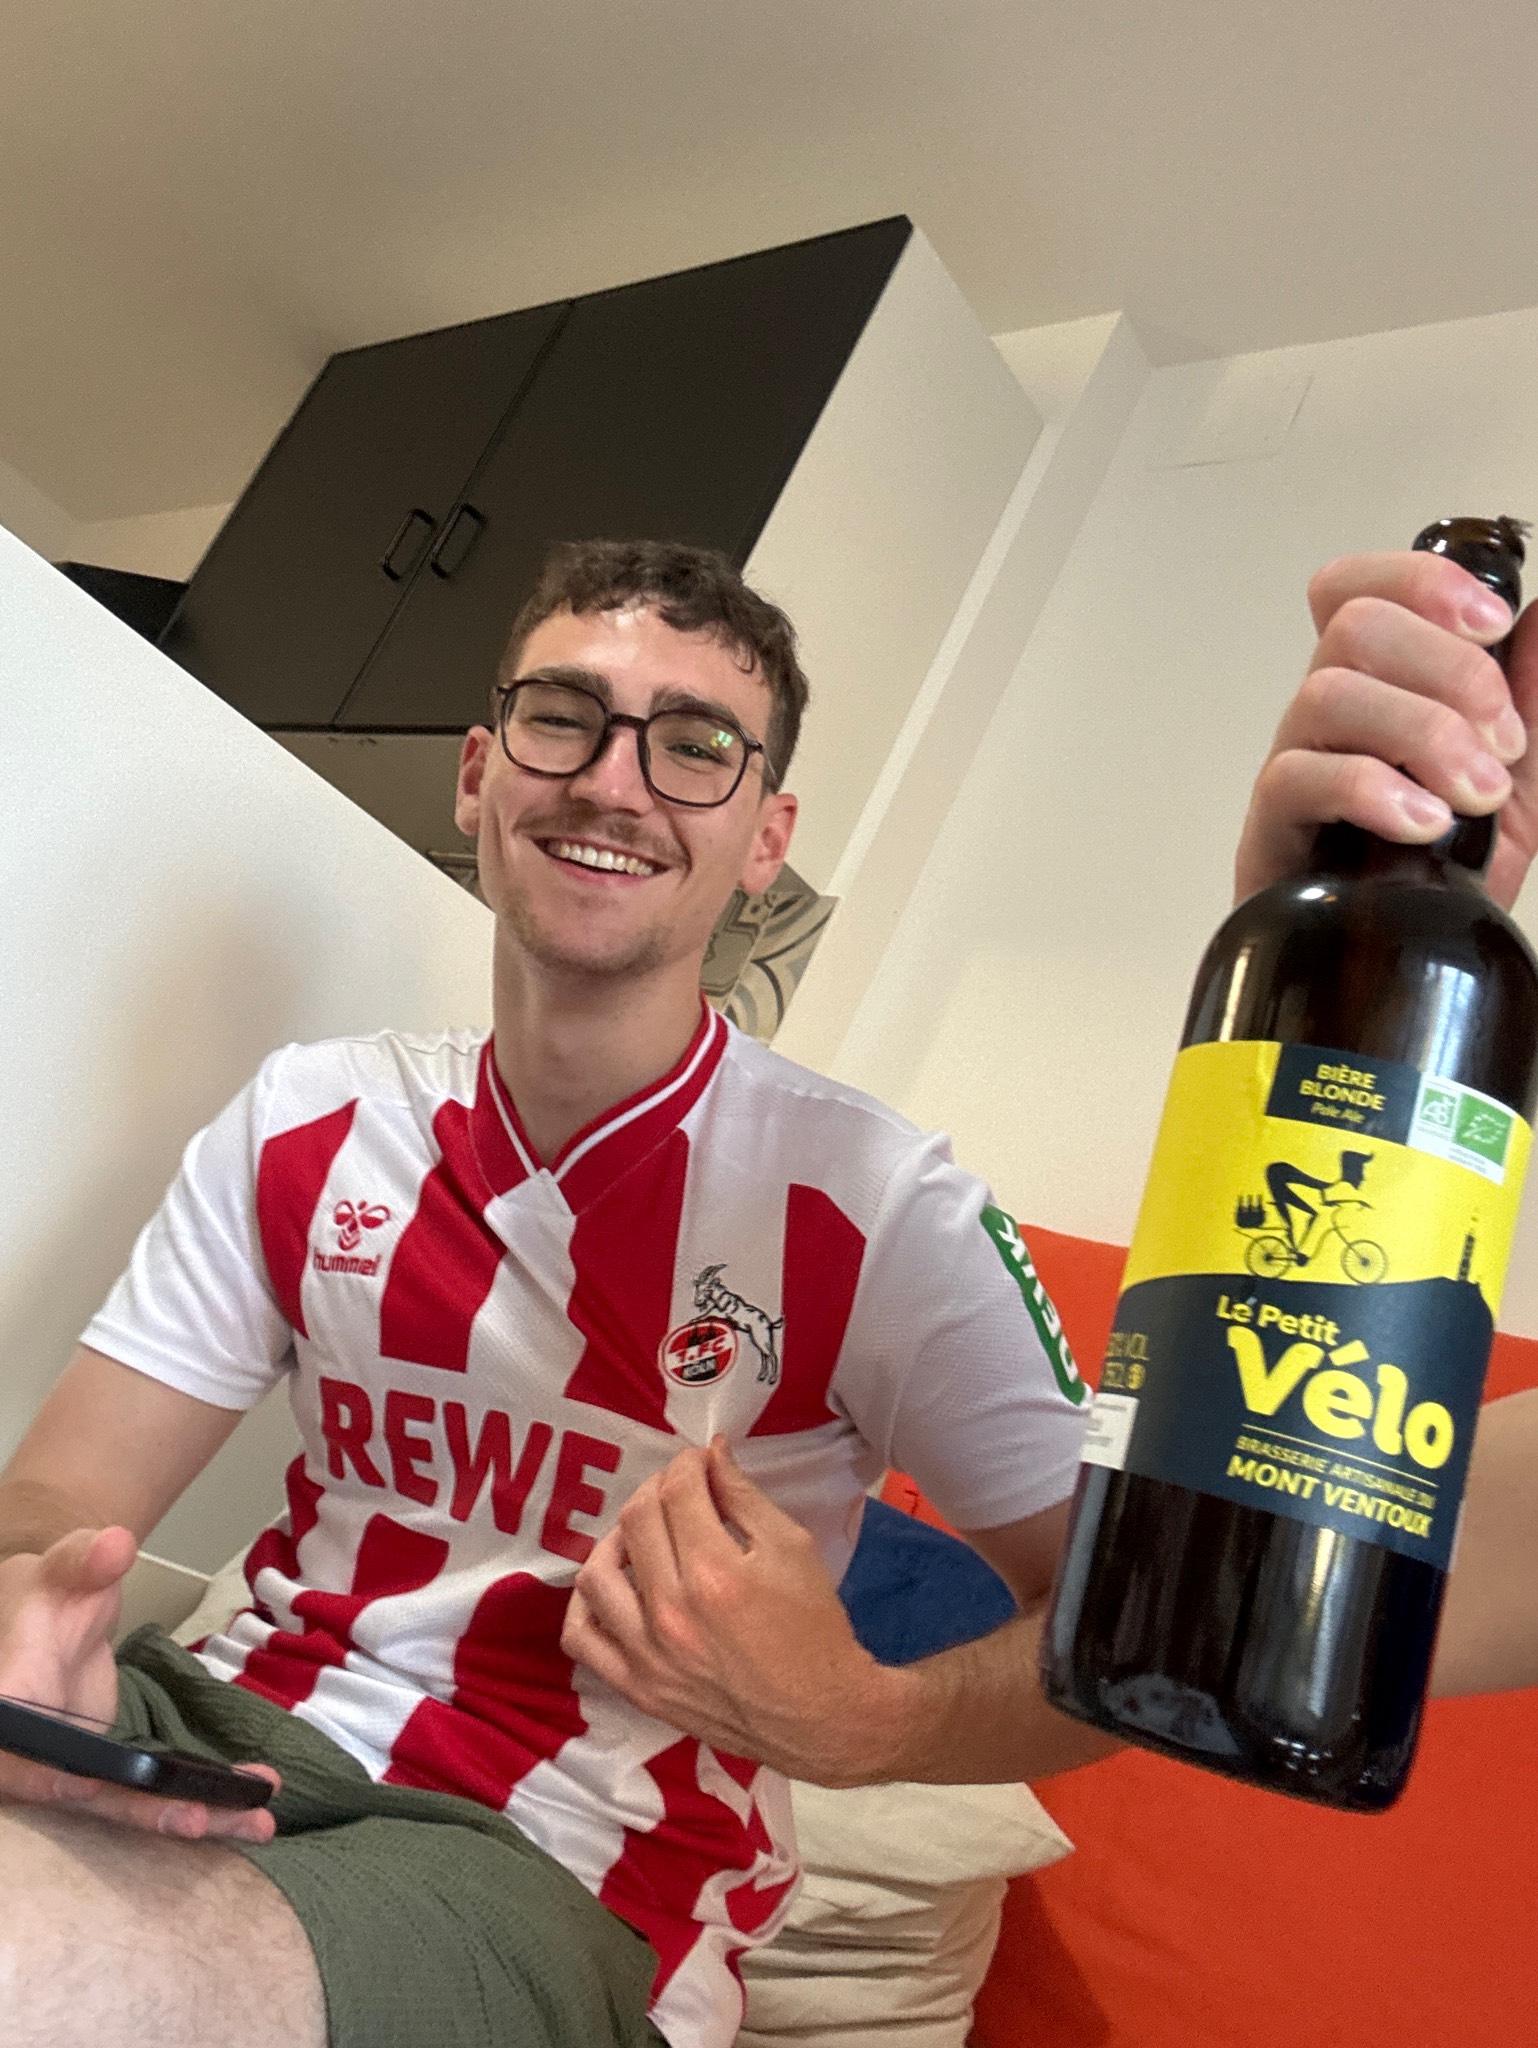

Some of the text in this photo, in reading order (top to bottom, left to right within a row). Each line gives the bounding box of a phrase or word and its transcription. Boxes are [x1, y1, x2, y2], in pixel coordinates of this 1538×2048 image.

[1299, 1079, 1387, 1111] BLONDE
[1316, 1063, 1377, 1090] BIÈRE
[313, 1247, 383, 1277] hummel
[1257, 1304, 1341, 1346] Petit
[1227, 1325, 1454, 1469] Vélo
[320, 1376, 624, 1564] REWE
[1234, 1435, 1330, 1474] BRASSERIE
[1226, 1455, 1434, 1539] MONT VENTOUX
